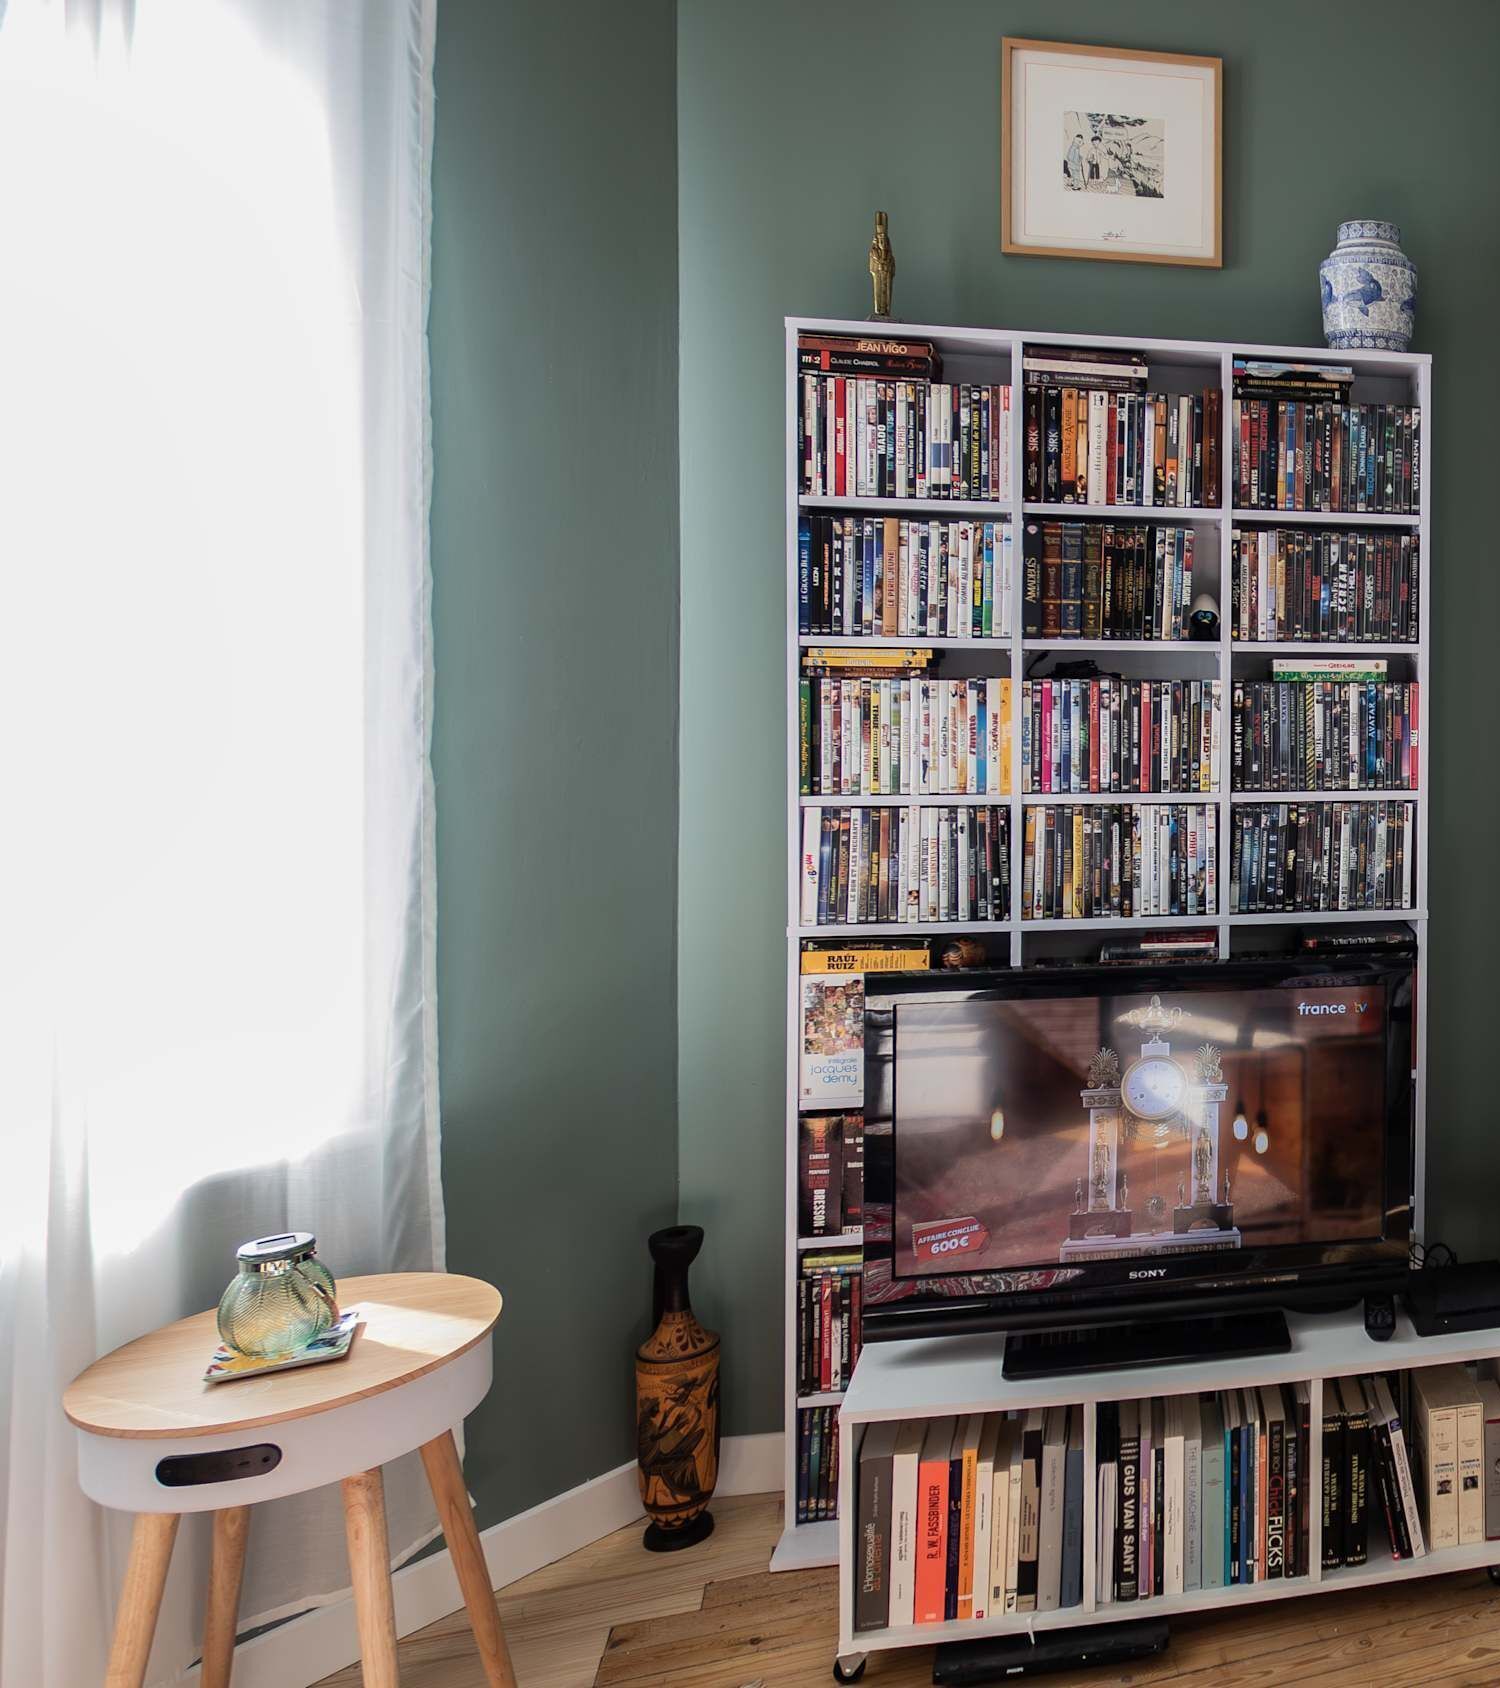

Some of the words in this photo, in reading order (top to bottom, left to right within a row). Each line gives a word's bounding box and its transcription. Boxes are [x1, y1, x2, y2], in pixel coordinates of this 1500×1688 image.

[856, 342, 881, 352] JEAN
[883, 344, 907, 354] VIGO
[877, 424, 886, 455] MADO
[1029, 430, 1039, 451] SIRK
[1049, 431, 1058, 452] SIRK
[1094, 424, 1102, 471] Hitchcock
[897, 455, 906, 465] LE
[973, 479, 980, 487] LA
[801, 549, 809, 567] BLEU
[887, 552, 895, 574] JEUNE
[1409, 552, 1418, 578] OMBRES
[801, 568, 809, 594] GRAND
[833, 540, 842, 616] NIKITA
[960, 572, 968, 580] AU
[1025, 557, 1038, 604] AMADEUS
[1348, 568, 1356, 589] HELL
[960, 582, 968, 604] HOMME
[1338, 564, 1347, 613] SCREAM
[801, 595, 809, 603] LE
[1348, 592, 1356, 612] FROM
[1409, 588, 1418, 613] SILENCE
[1234, 714, 1243, 732] HILL
[1234, 735, 1243, 766] SILENT
[921, 837, 929, 855] DEUX
[1189, 831, 1198, 858] FARGO
[806, 854, 817, 875] BOUM
[849, 856, 859, 866] LES
[849, 869, 859, 877] ET
[940, 872, 948, 890] TENUE
[849, 880, 859, 892] BON
[828, 954, 858, 963] RAÚL
[828, 962, 856, 970] RUIZ
[1297, 1002, 1346, 1015] france
[1354, 1001, 1368, 1013] tv
[811, 1064, 857, 1075] jacques
[823, 1074, 858, 1085] demy
[813, 1189, 826, 1228] BRESSON
[918, 1231, 948, 1245] AFFAIRE
[947, 1224, 980, 1236] CONCLUE
[931, 1236, 969, 1254] 600€
[1129, 1269, 1167, 1279] SONY
[1271, 1435, 1281, 1454] RUBY
[1271, 1456, 1281, 1473] RICH
[1123, 1465, 1136, 1497] GUS
[926, 1486, 939, 1537] FASSBINDER
[1123, 1499, 1136, 1529] VAN
[1188, 1491, 1198, 1531] MACHINE
[926, 1539, 939, 1549] W.
[863, 1523, 876, 1592] L'Homosexualité
[926, 1551, 939, 1560] R.
[1123, 1535, 1136, 1574] SANT
